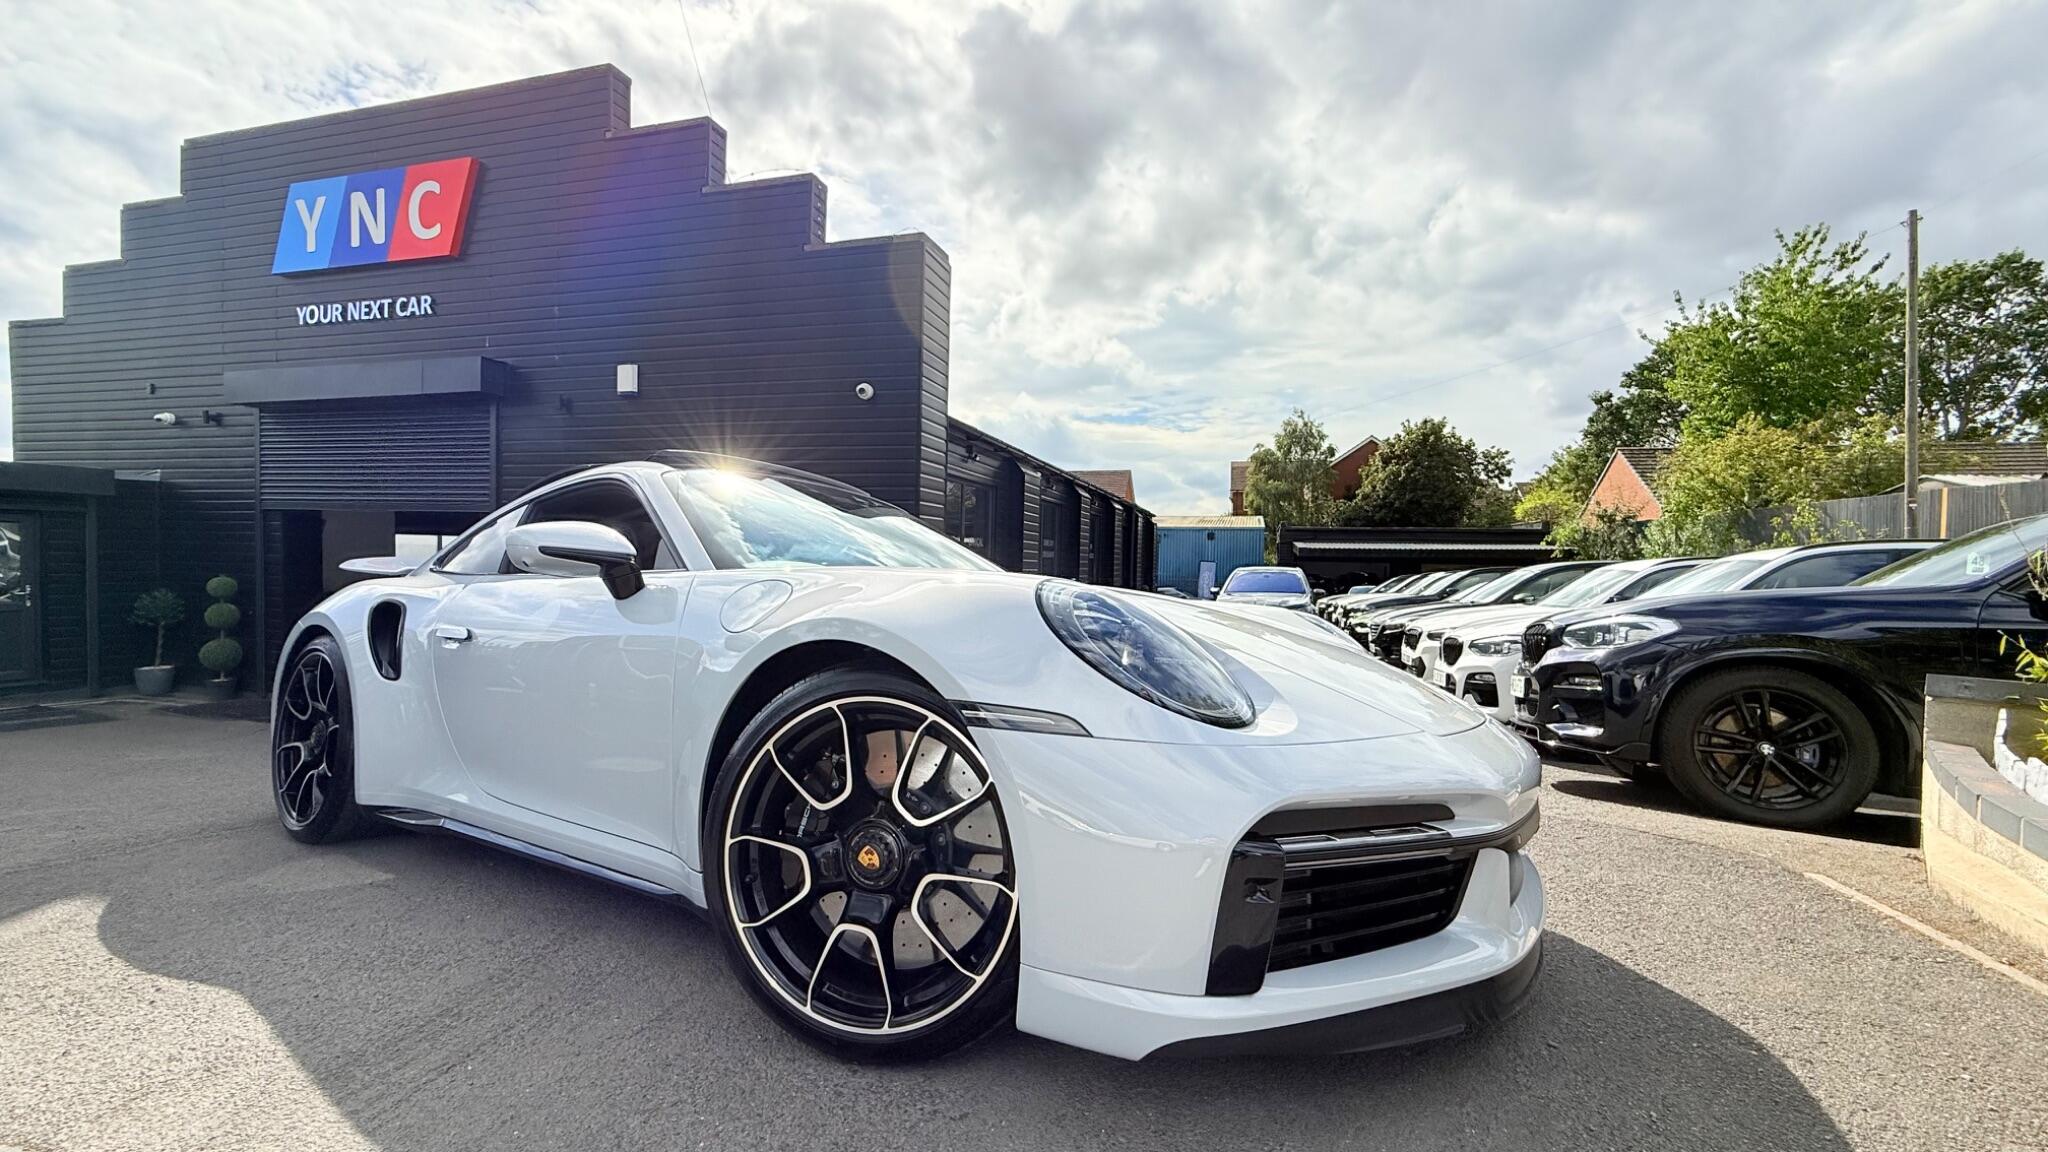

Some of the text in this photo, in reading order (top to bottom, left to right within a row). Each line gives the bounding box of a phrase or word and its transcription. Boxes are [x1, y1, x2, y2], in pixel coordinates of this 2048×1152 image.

[295, 180, 442, 253] YNC
[296, 295, 433, 325] YOUR NEXT CAR
